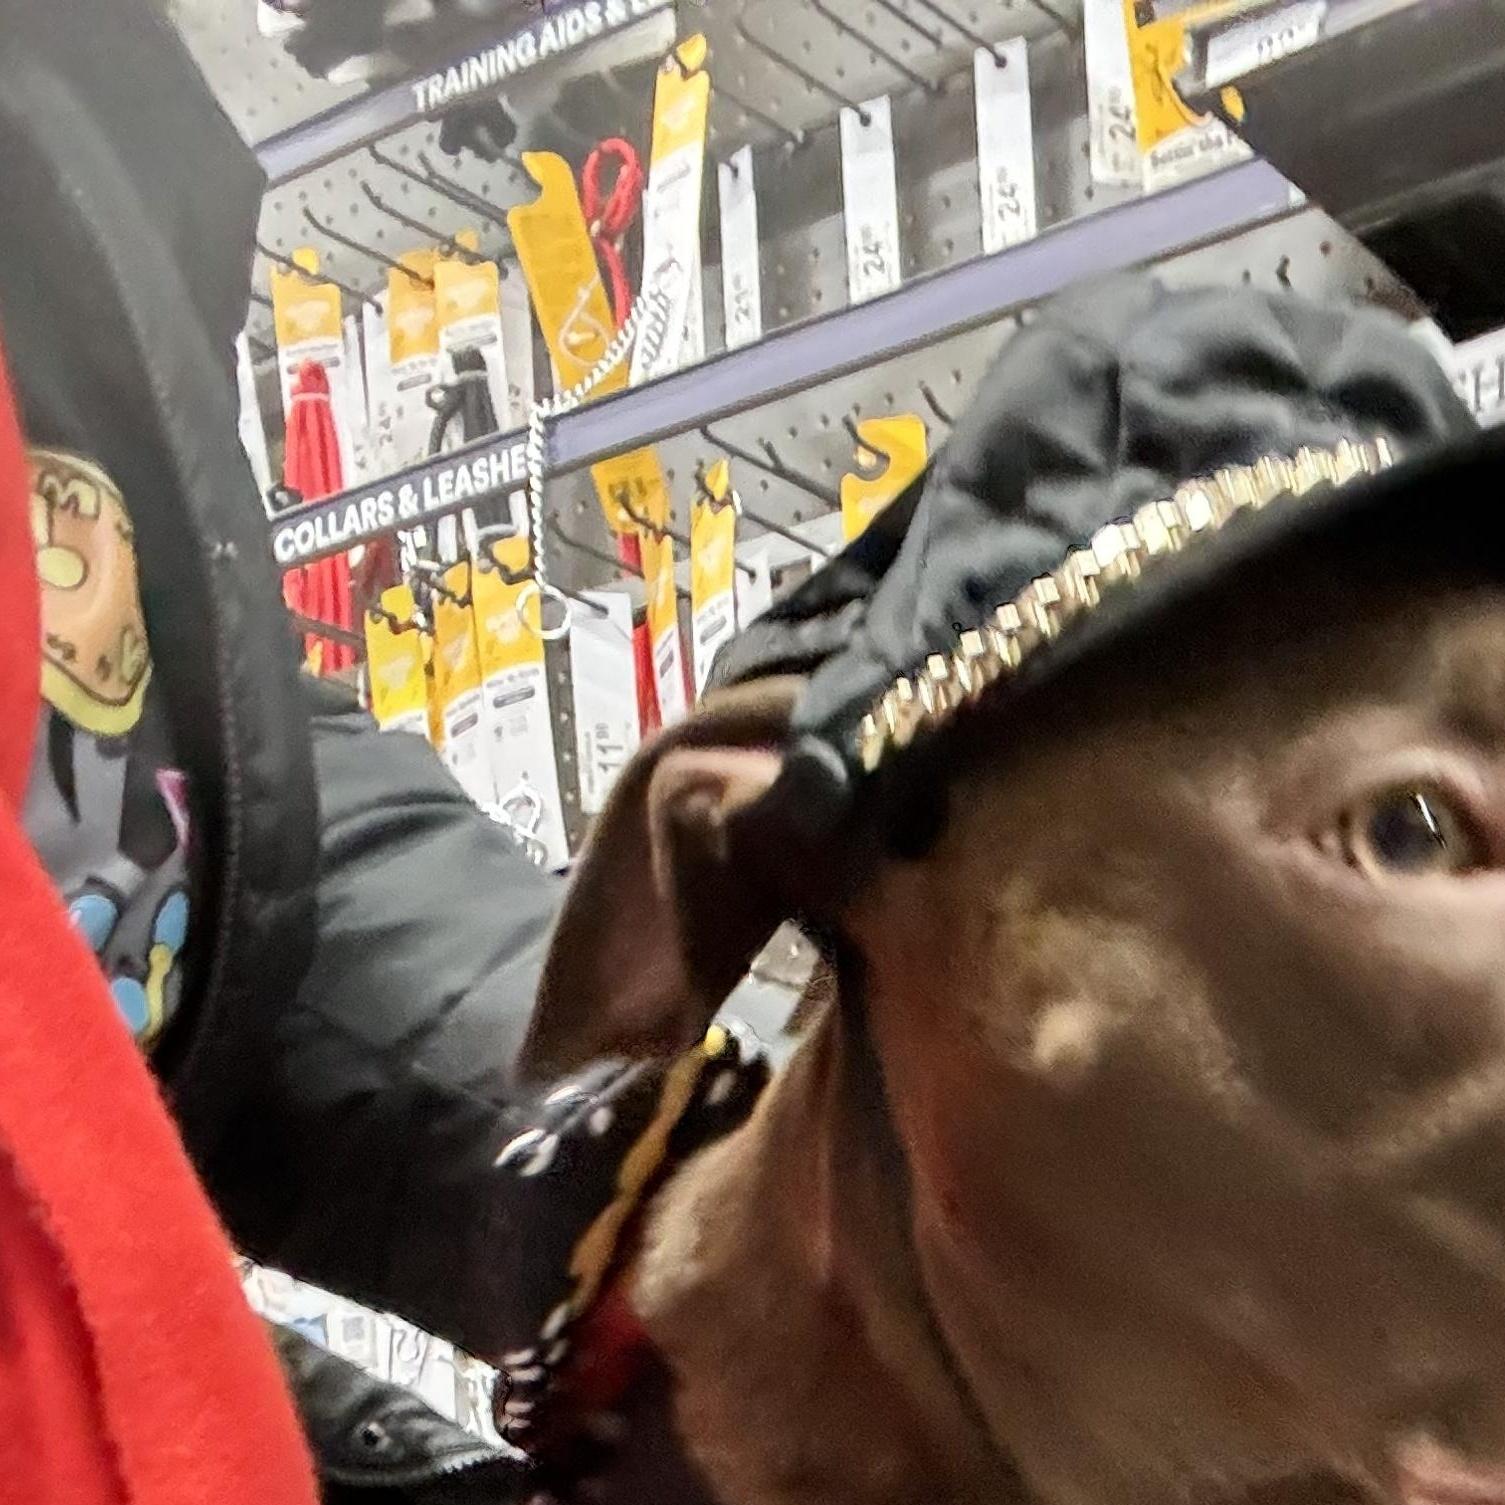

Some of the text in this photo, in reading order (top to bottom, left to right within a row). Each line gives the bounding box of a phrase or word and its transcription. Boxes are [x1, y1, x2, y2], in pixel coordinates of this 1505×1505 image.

[411, 31, 538, 112] TRAINING
[539, 1, 602, 56] AIDS
[273, 491, 396, 564] COLLARS
[397, 483, 419, 519] &
[422, 442, 542, 505] LEASHE
